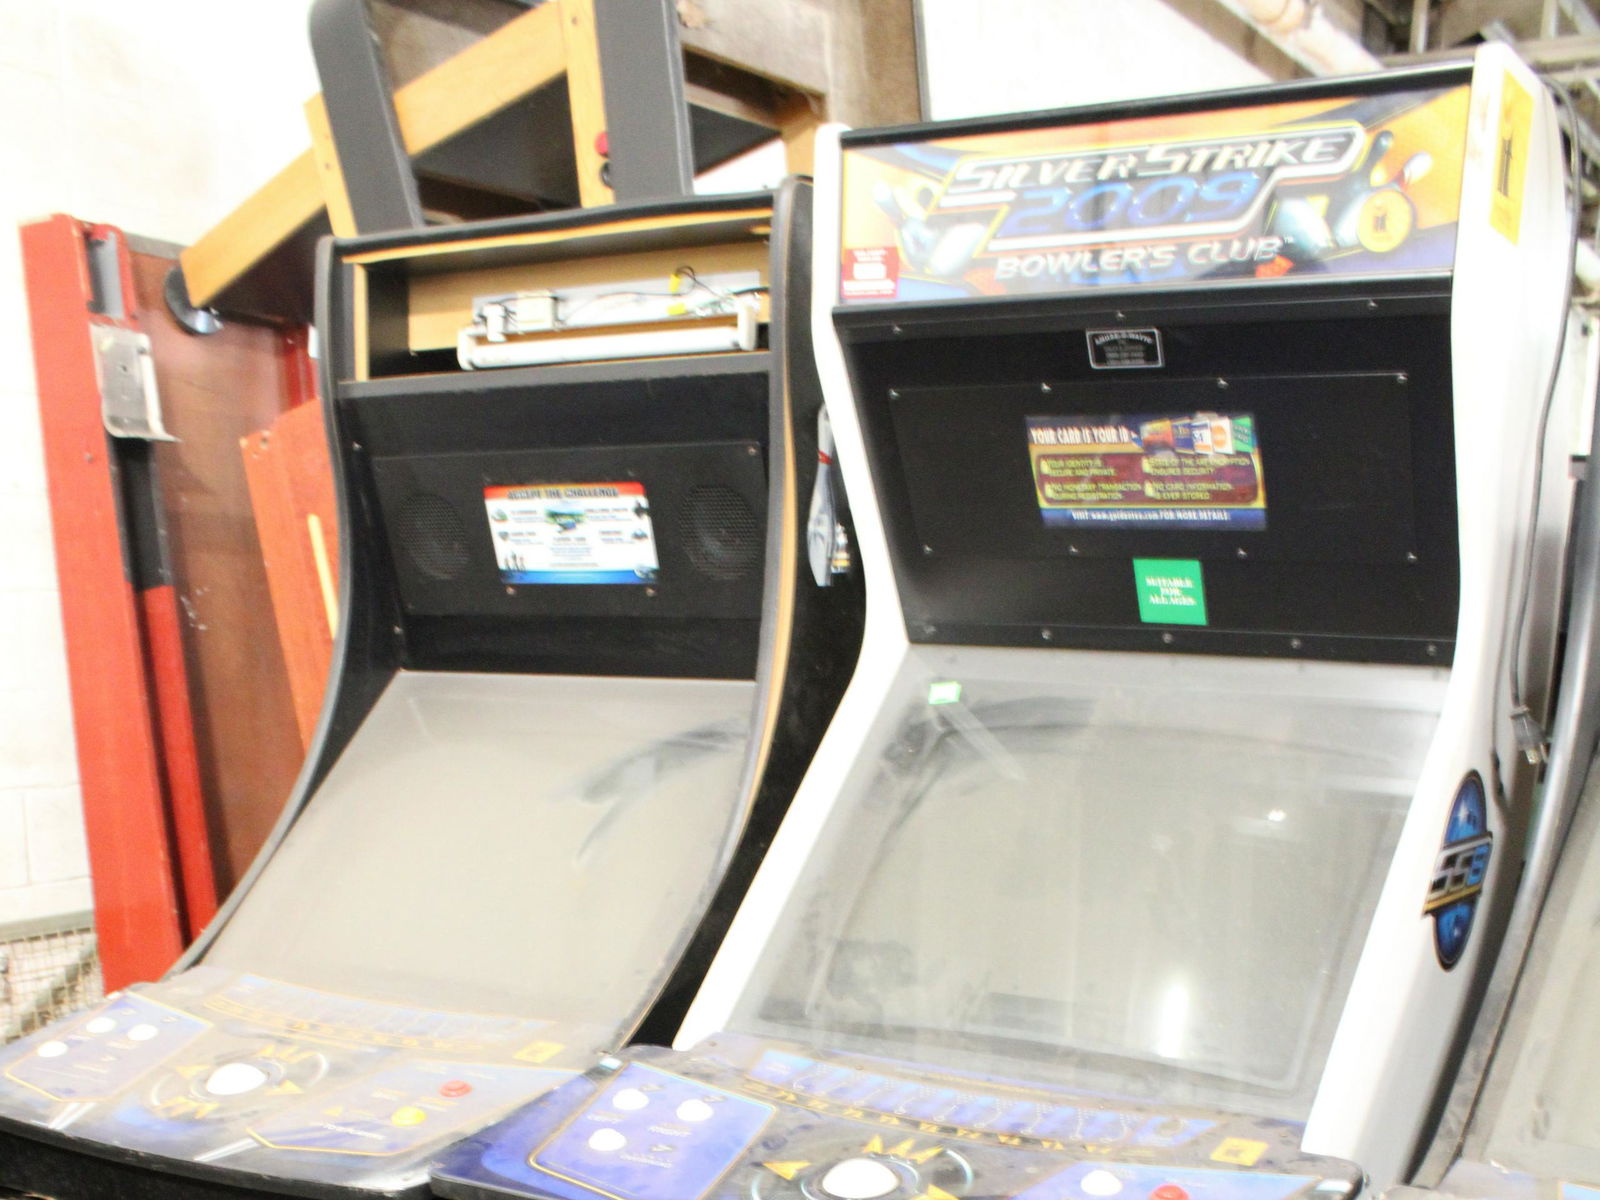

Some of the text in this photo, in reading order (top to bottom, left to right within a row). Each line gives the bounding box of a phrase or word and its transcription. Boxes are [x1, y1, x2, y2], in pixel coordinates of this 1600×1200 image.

[948, 137, 1345, 193] SILVER STRIKE
[996, 172, 1260, 237] 2009
[995, 245, 1176, 280] BOWLER'S
[1187, 237, 1283, 264] CLUB
[1031, 425, 1129, 444] YOUR CARD IS YOUR ID
[507, 487, 619, 499] ACCEPT THE CHALLENGE
[1072, 510, 1088, 520] VISIT
[1160, 509, 1175, 520] FOR
[1177, 509, 1197, 520] MORE
